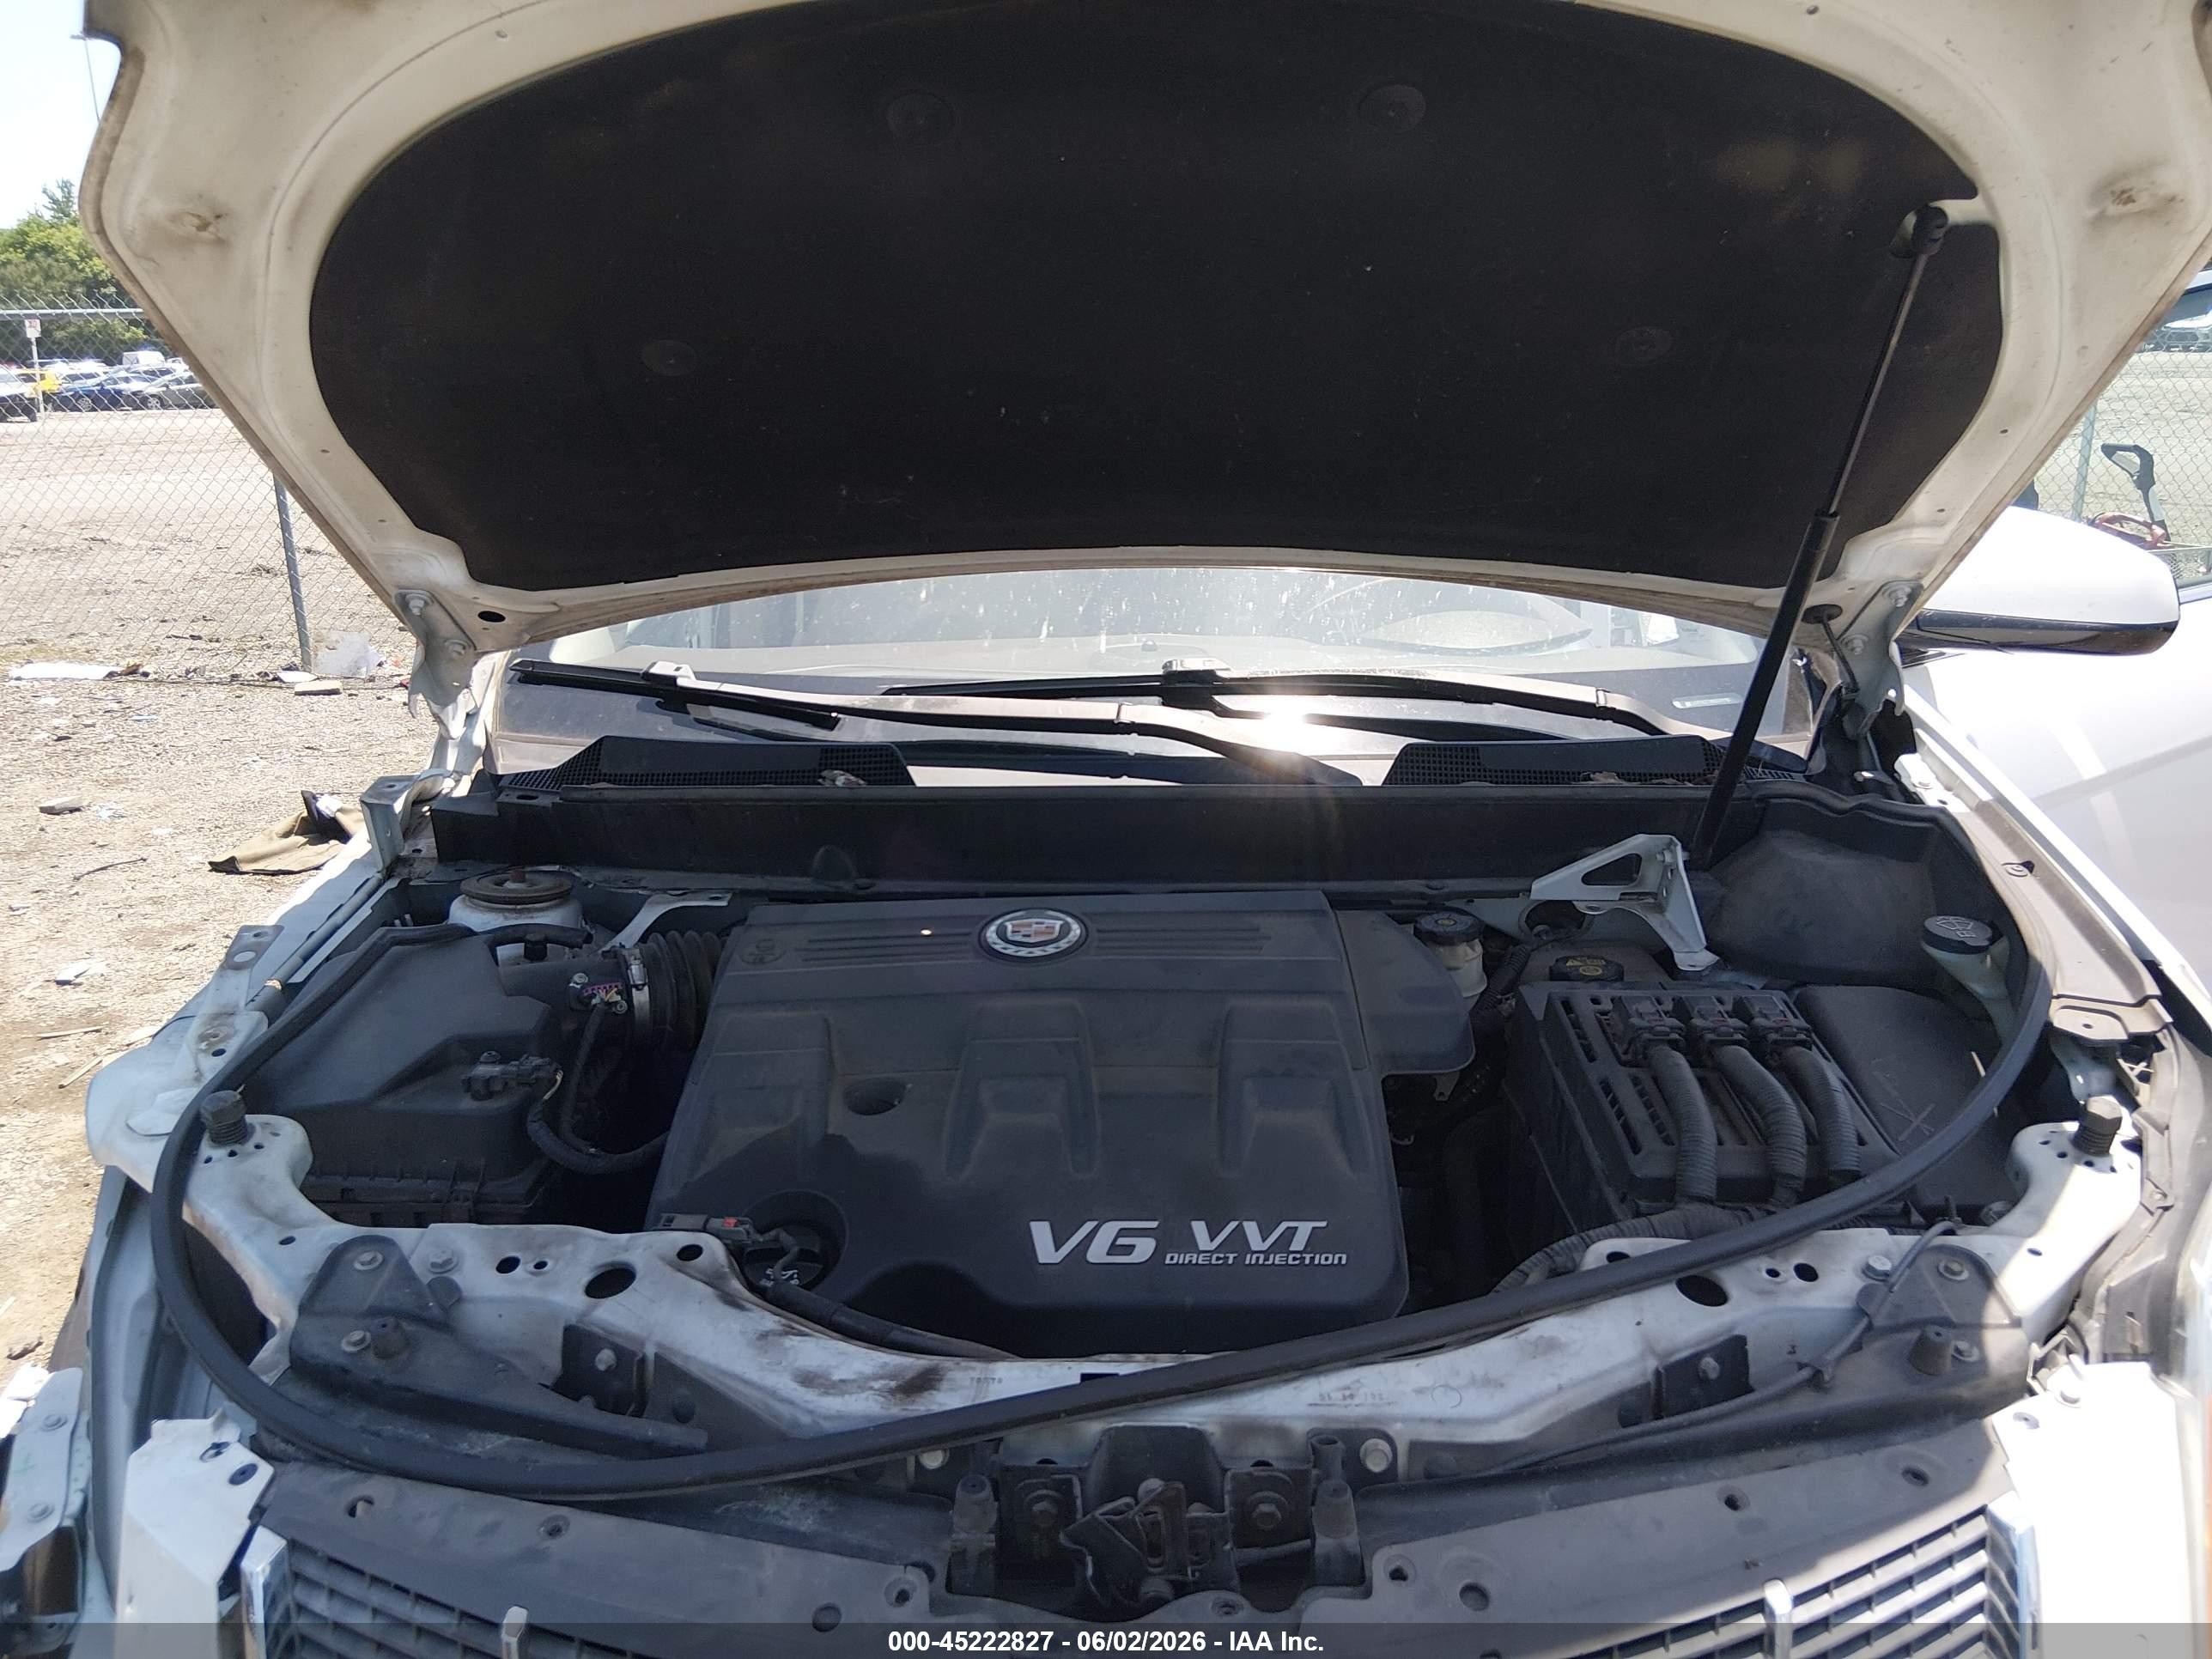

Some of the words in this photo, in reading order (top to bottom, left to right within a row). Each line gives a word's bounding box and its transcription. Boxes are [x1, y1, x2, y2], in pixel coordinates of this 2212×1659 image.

[1029, 1220, 1160, 1264] V6
[1190, 1220, 1328, 1251] VVT
[1164, 1253, 1238, 1265] DIRECT
[1244, 1253, 1347, 1265] INJECTION
